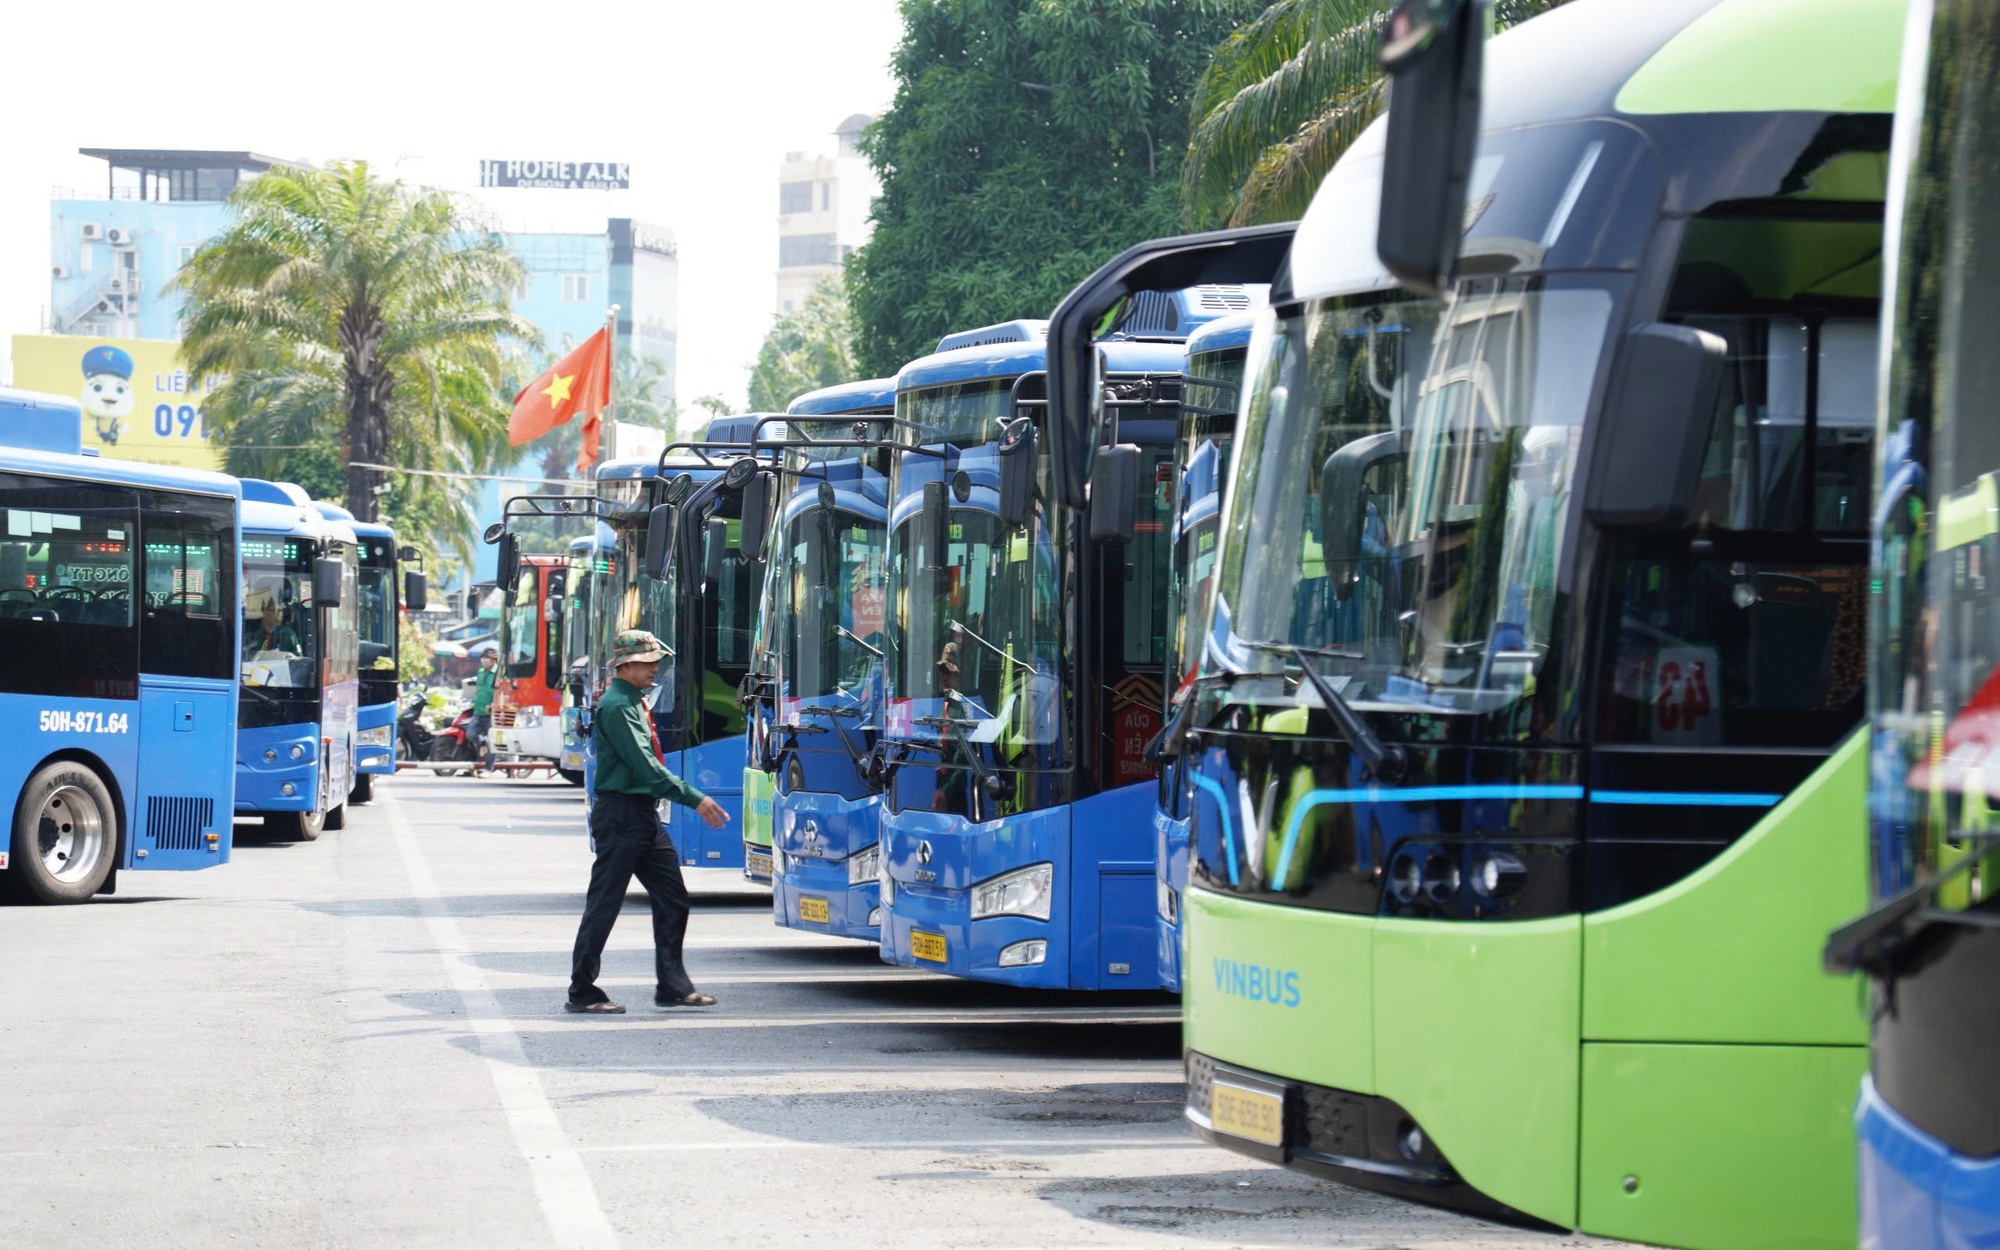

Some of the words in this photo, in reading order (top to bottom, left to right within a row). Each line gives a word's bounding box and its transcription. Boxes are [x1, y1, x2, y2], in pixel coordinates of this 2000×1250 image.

[507, 160, 629, 181] HOMETALK
[517, 178, 565, 189] DESIGN
[569, 180, 578, 189] &
[583, 181, 620, 190] BUILD
[39, 710, 128, 734] 50H-871.64
[1213, 956, 1301, 1008] VINBUS
